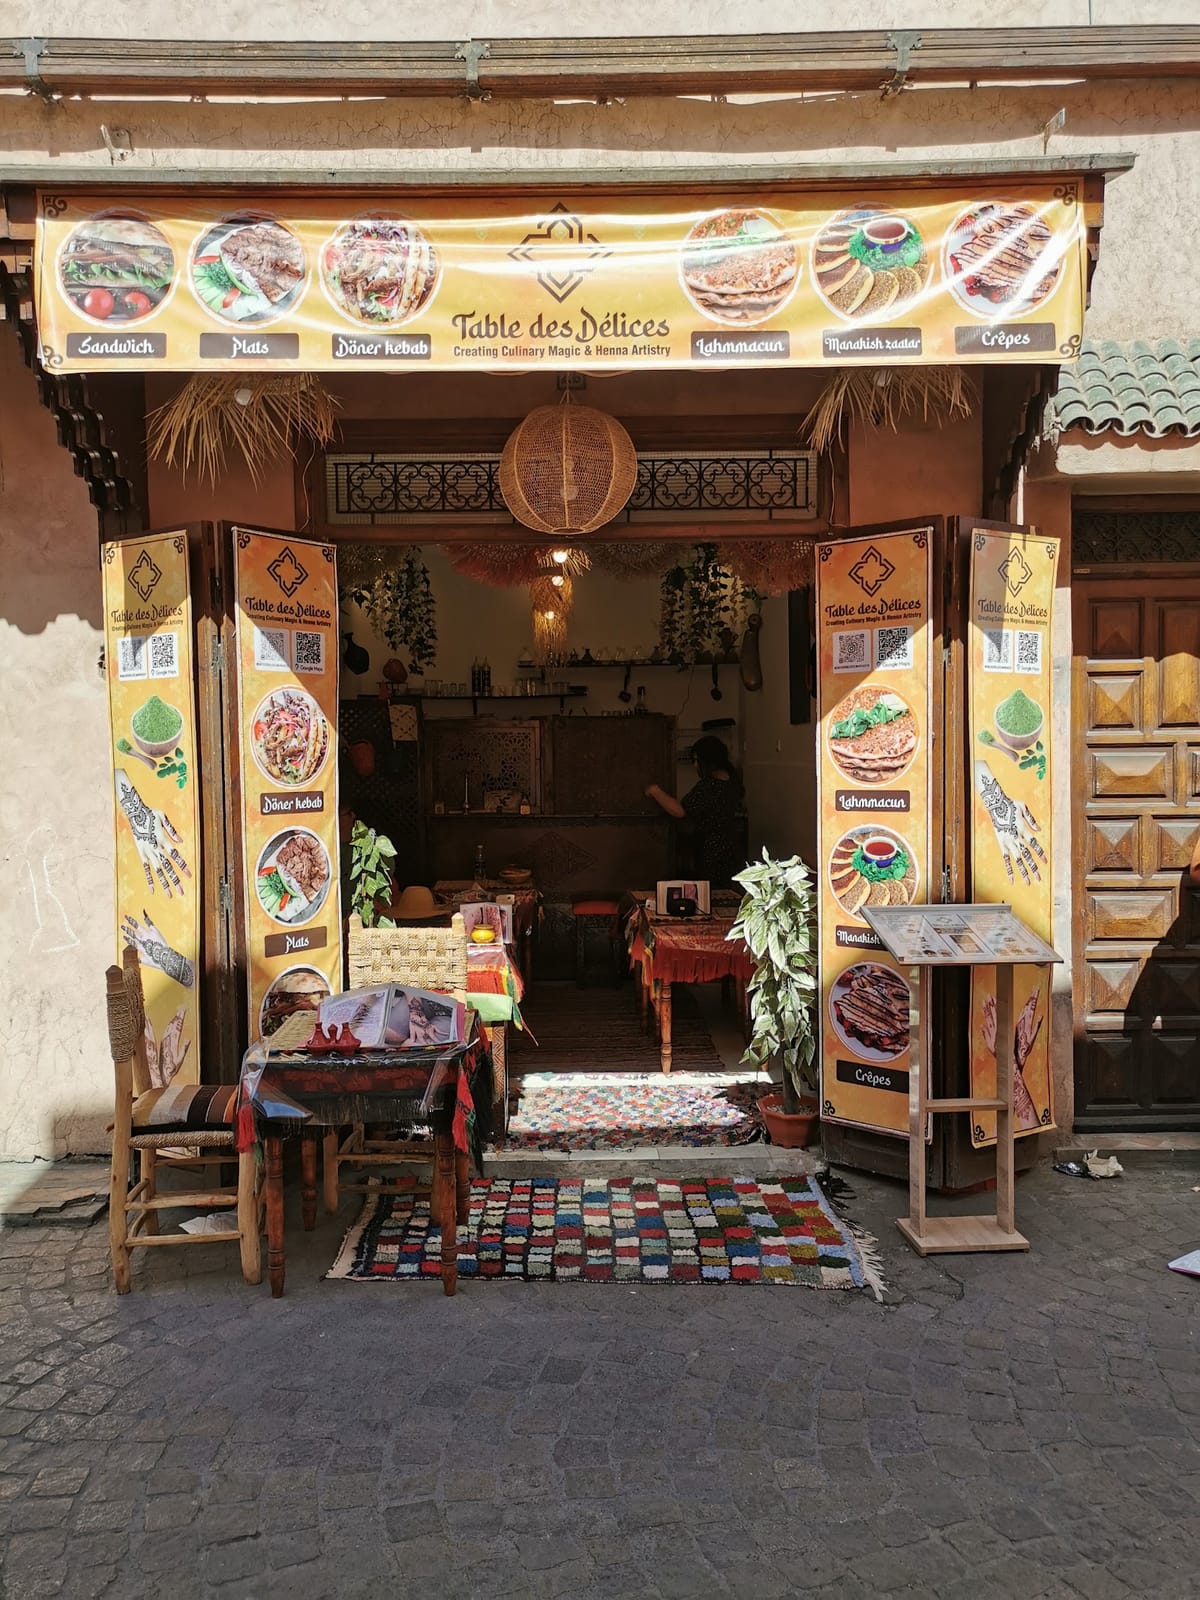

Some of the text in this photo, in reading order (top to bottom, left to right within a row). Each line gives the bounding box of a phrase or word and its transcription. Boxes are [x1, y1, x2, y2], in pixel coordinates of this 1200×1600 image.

[452, 306, 670, 343] Table des Délices
[78, 335, 155, 355] Sandwich
[231, 336, 270, 358] Plats
[335, 336, 429, 358] Döner kebab
[695, 338, 785, 357] Lahmmacun
[824, 336, 884, 354] Manakish
[981, 330, 1031, 350] Crêpes
[453, 344, 671, 358] Creating Culinary Magic & Henna Artistry
[111, 603, 183, 623] Table des Délices
[245, 596, 331, 619] Table des Délices
[825, 598, 921, 618] Table des Délices
[977, 599, 1002, 613] Table
[1003, 602, 1019, 614] des
[262, 796, 323, 814] Döner kebab
[838, 796, 907, 811] Lahmmacun
[284, 935, 310, 954] Plats
[836, 929, 881, 945] Manakish
[855, 1068, 892, 1087] Crêpes
